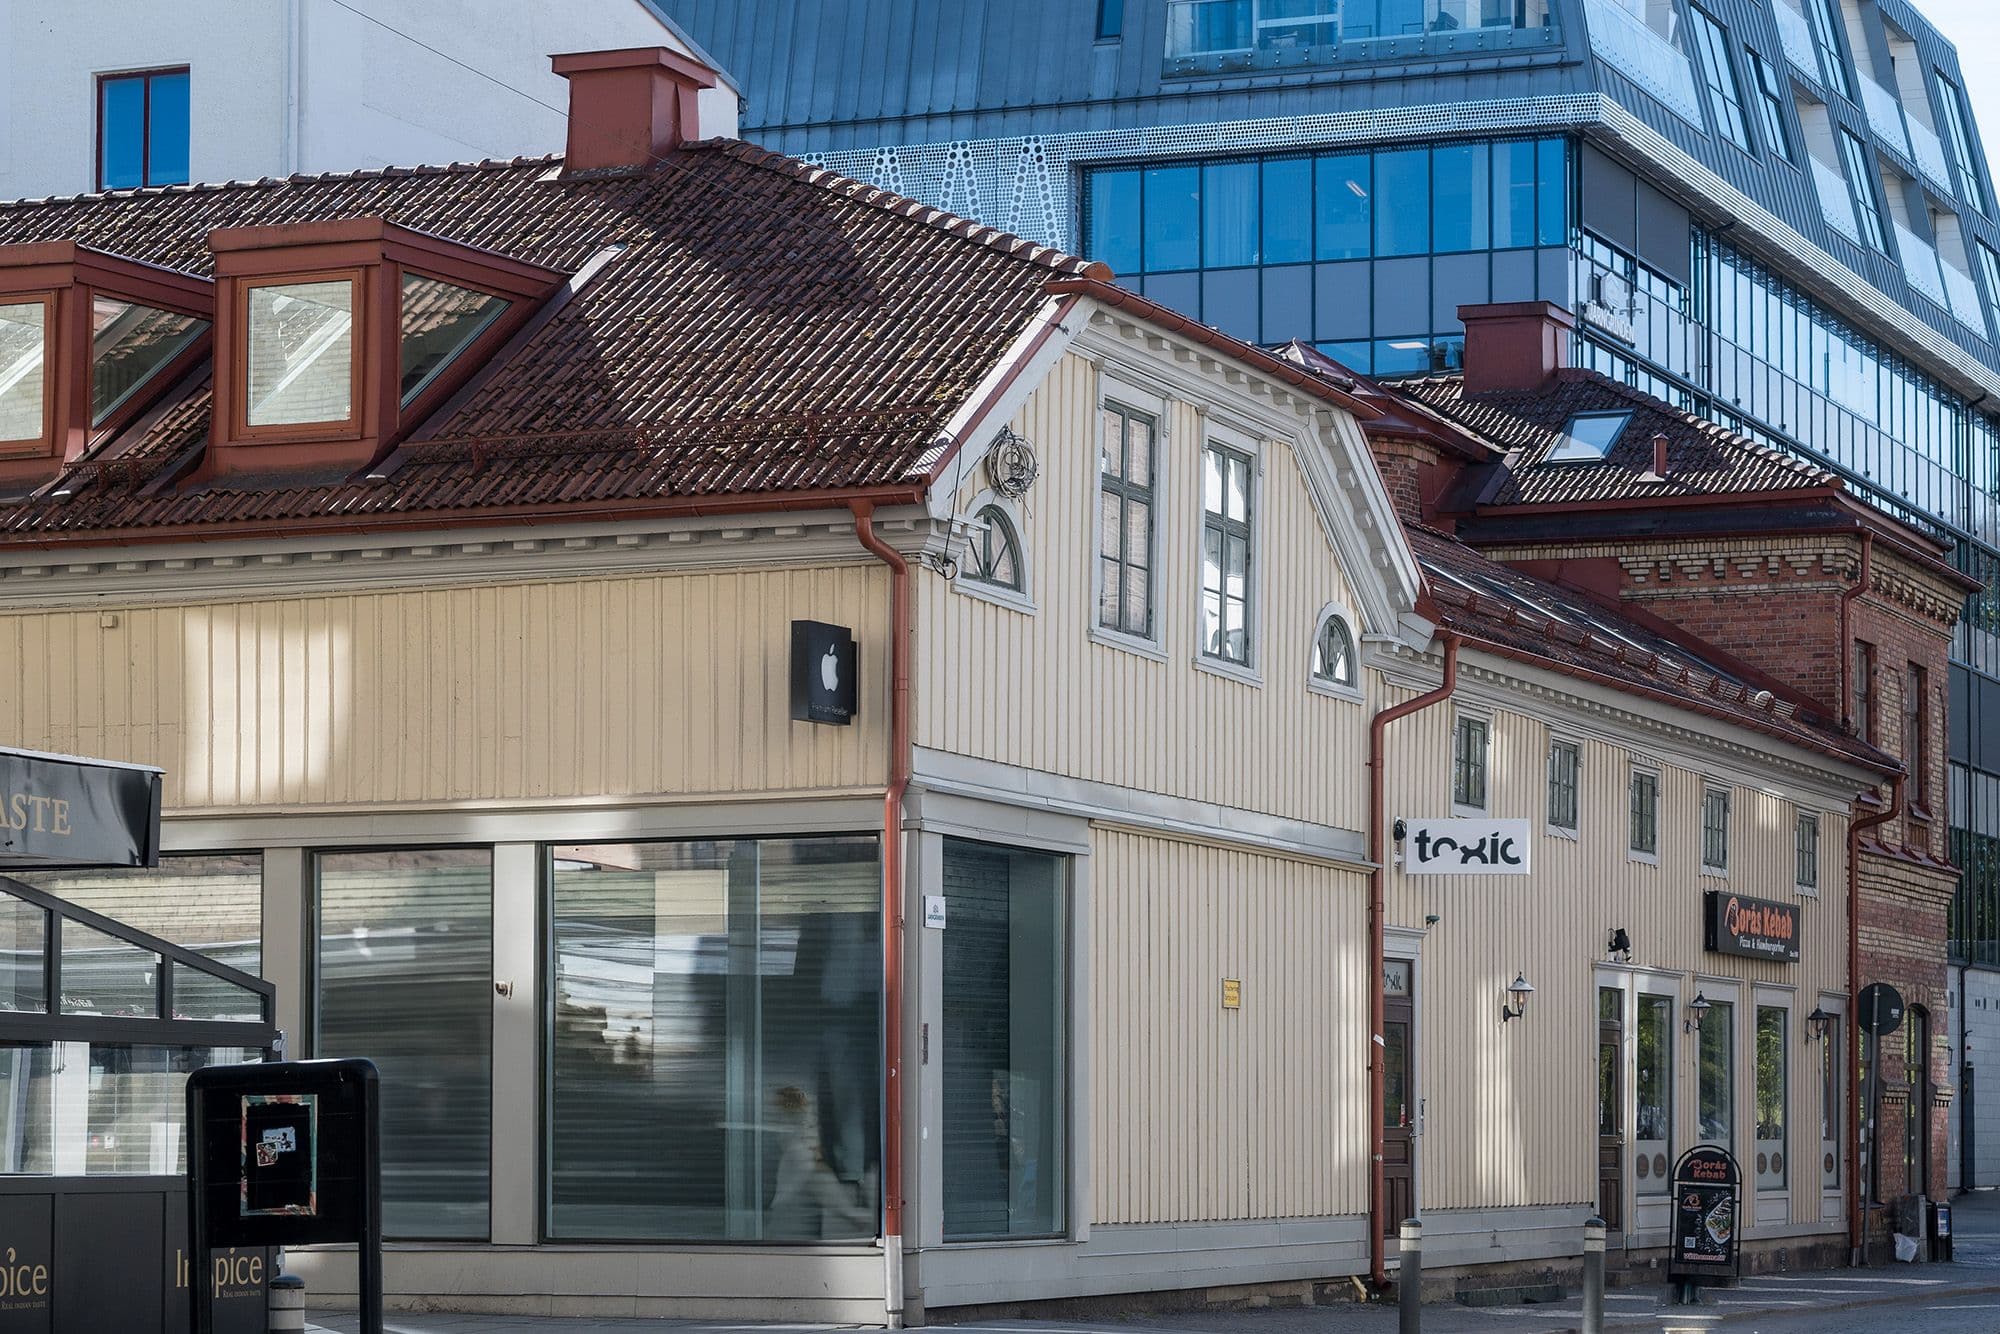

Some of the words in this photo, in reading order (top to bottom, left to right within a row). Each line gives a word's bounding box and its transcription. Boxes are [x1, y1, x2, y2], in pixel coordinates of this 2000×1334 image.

[1414, 828, 1521, 865] toxic
[1763, 906, 1793, 939] Kebab
[1693, 1169, 1726, 1179] Kebab
